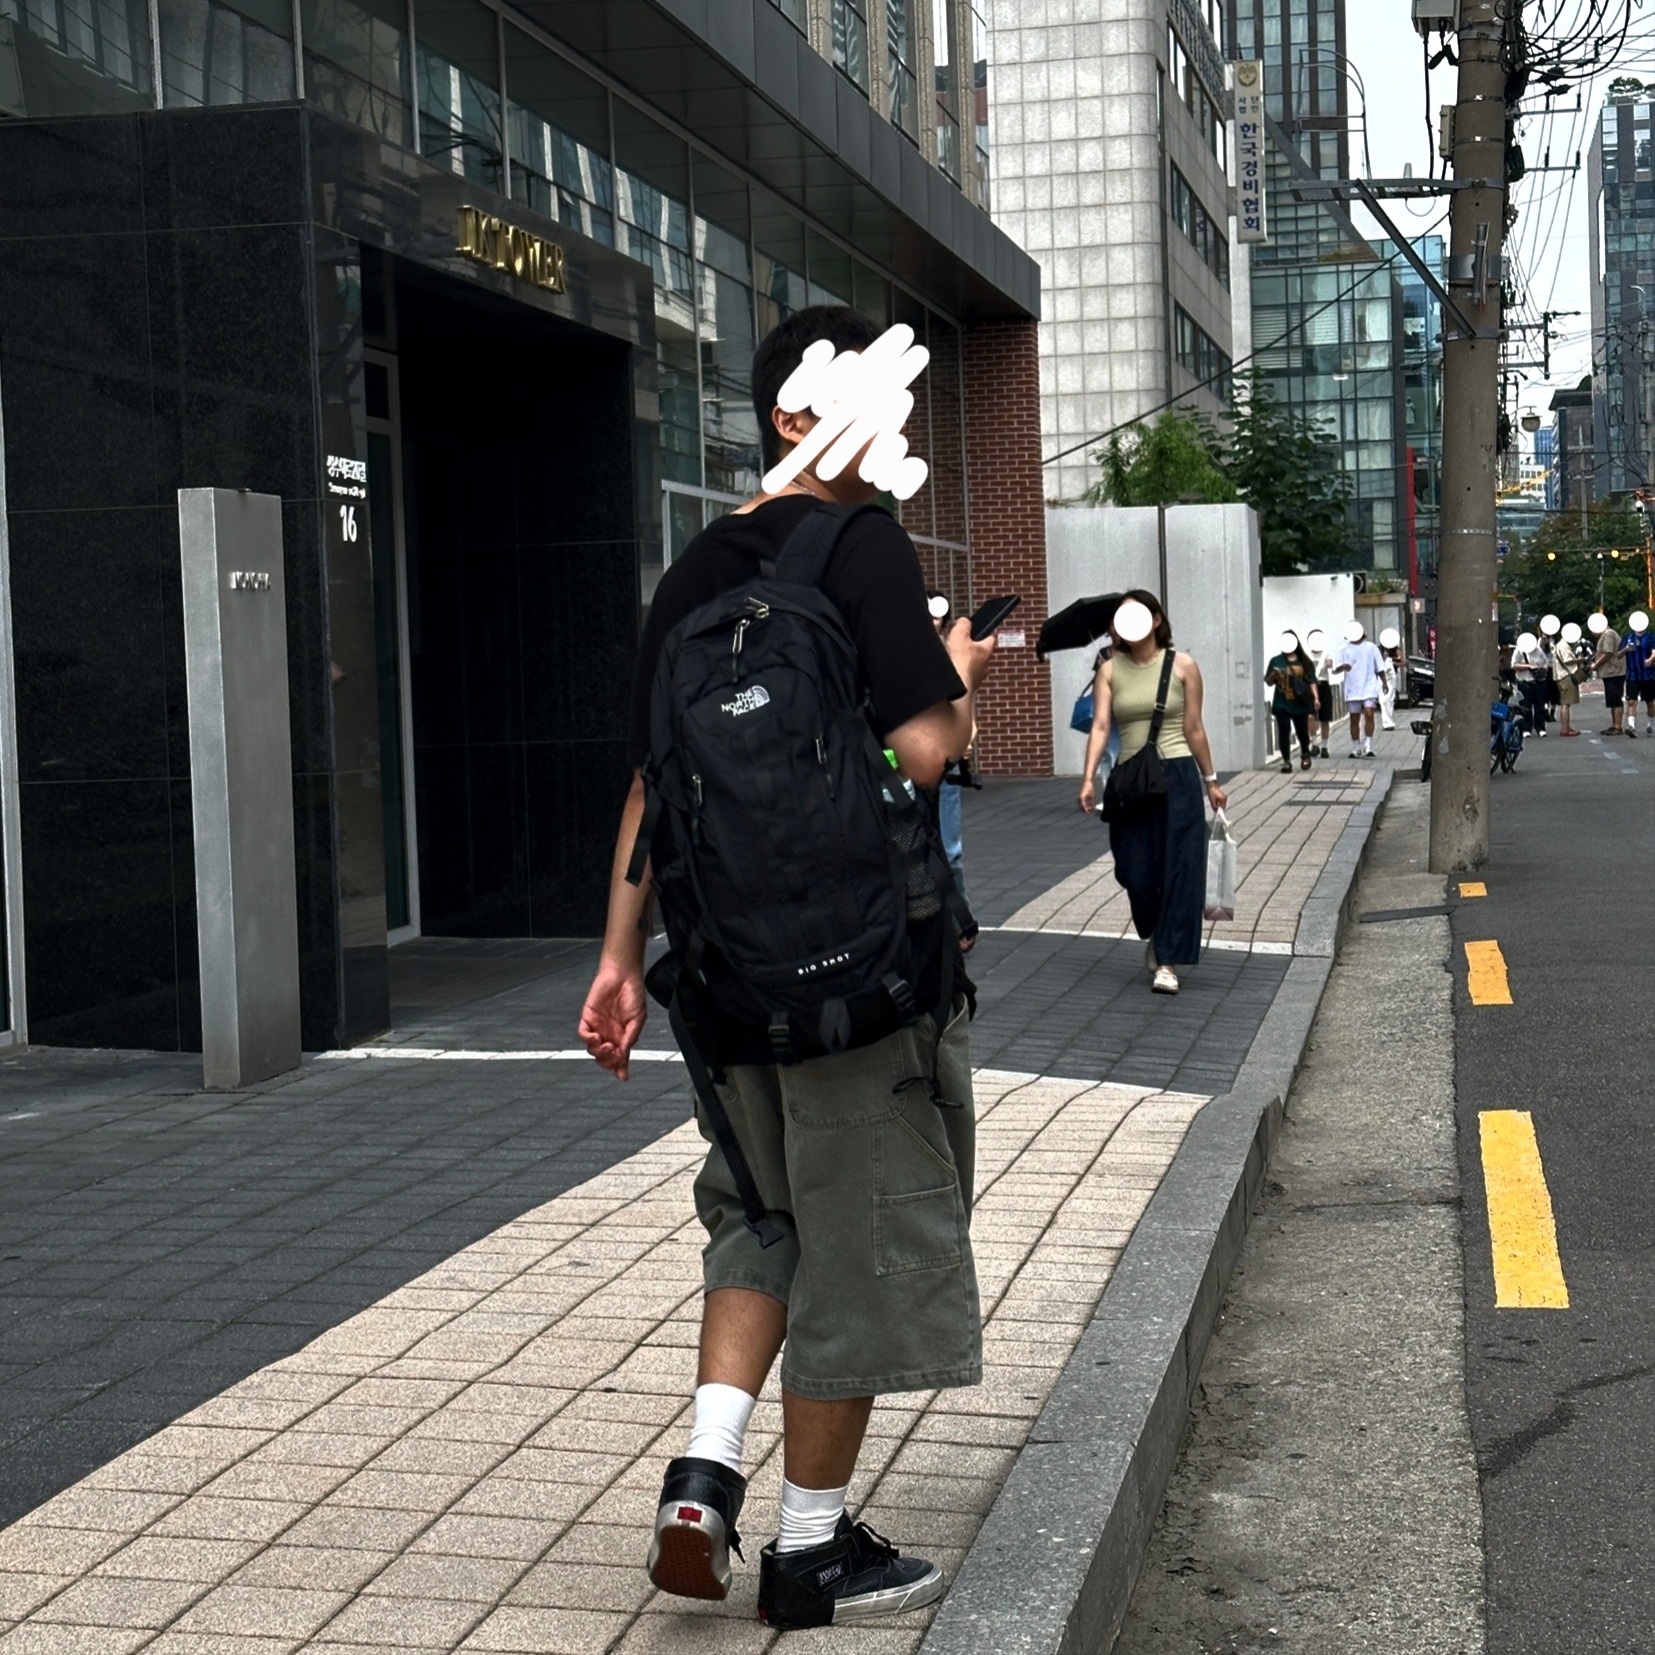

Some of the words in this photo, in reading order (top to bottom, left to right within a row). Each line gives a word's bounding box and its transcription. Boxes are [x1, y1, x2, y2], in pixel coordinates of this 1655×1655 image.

[1240, 123, 1260, 231] 한국경비협회
[340, 504, 357, 542] 16
[735, 687, 753, 701] THE
[721, 697, 755, 712] NORTH
[732, 702, 755, 717] FACE
[798, 964, 817, 975] BIG
[822, 953, 849, 967] SHOT
